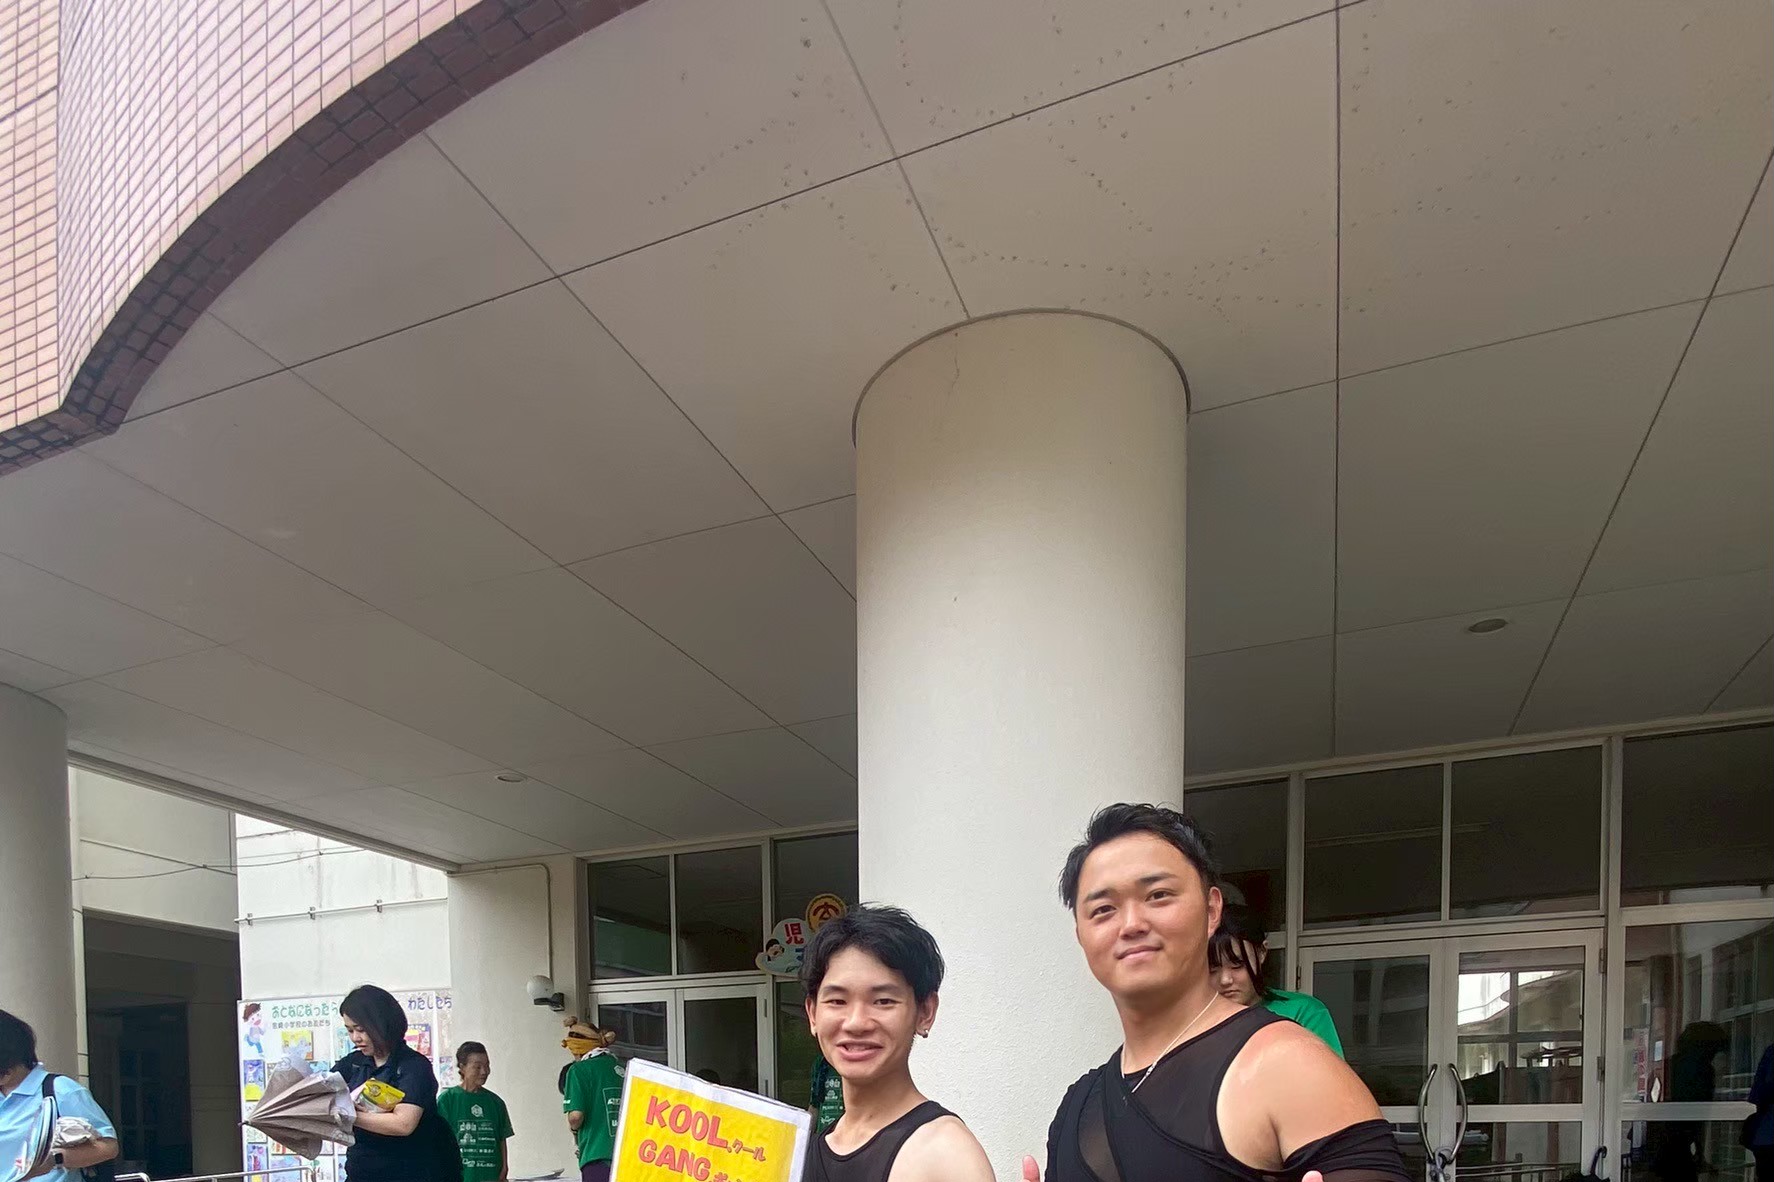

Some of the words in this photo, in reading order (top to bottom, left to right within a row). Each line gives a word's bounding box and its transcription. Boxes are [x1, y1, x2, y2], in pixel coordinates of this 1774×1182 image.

[784, 923, 804, 945] 児
[732, 1139, 766, 1162] クール
